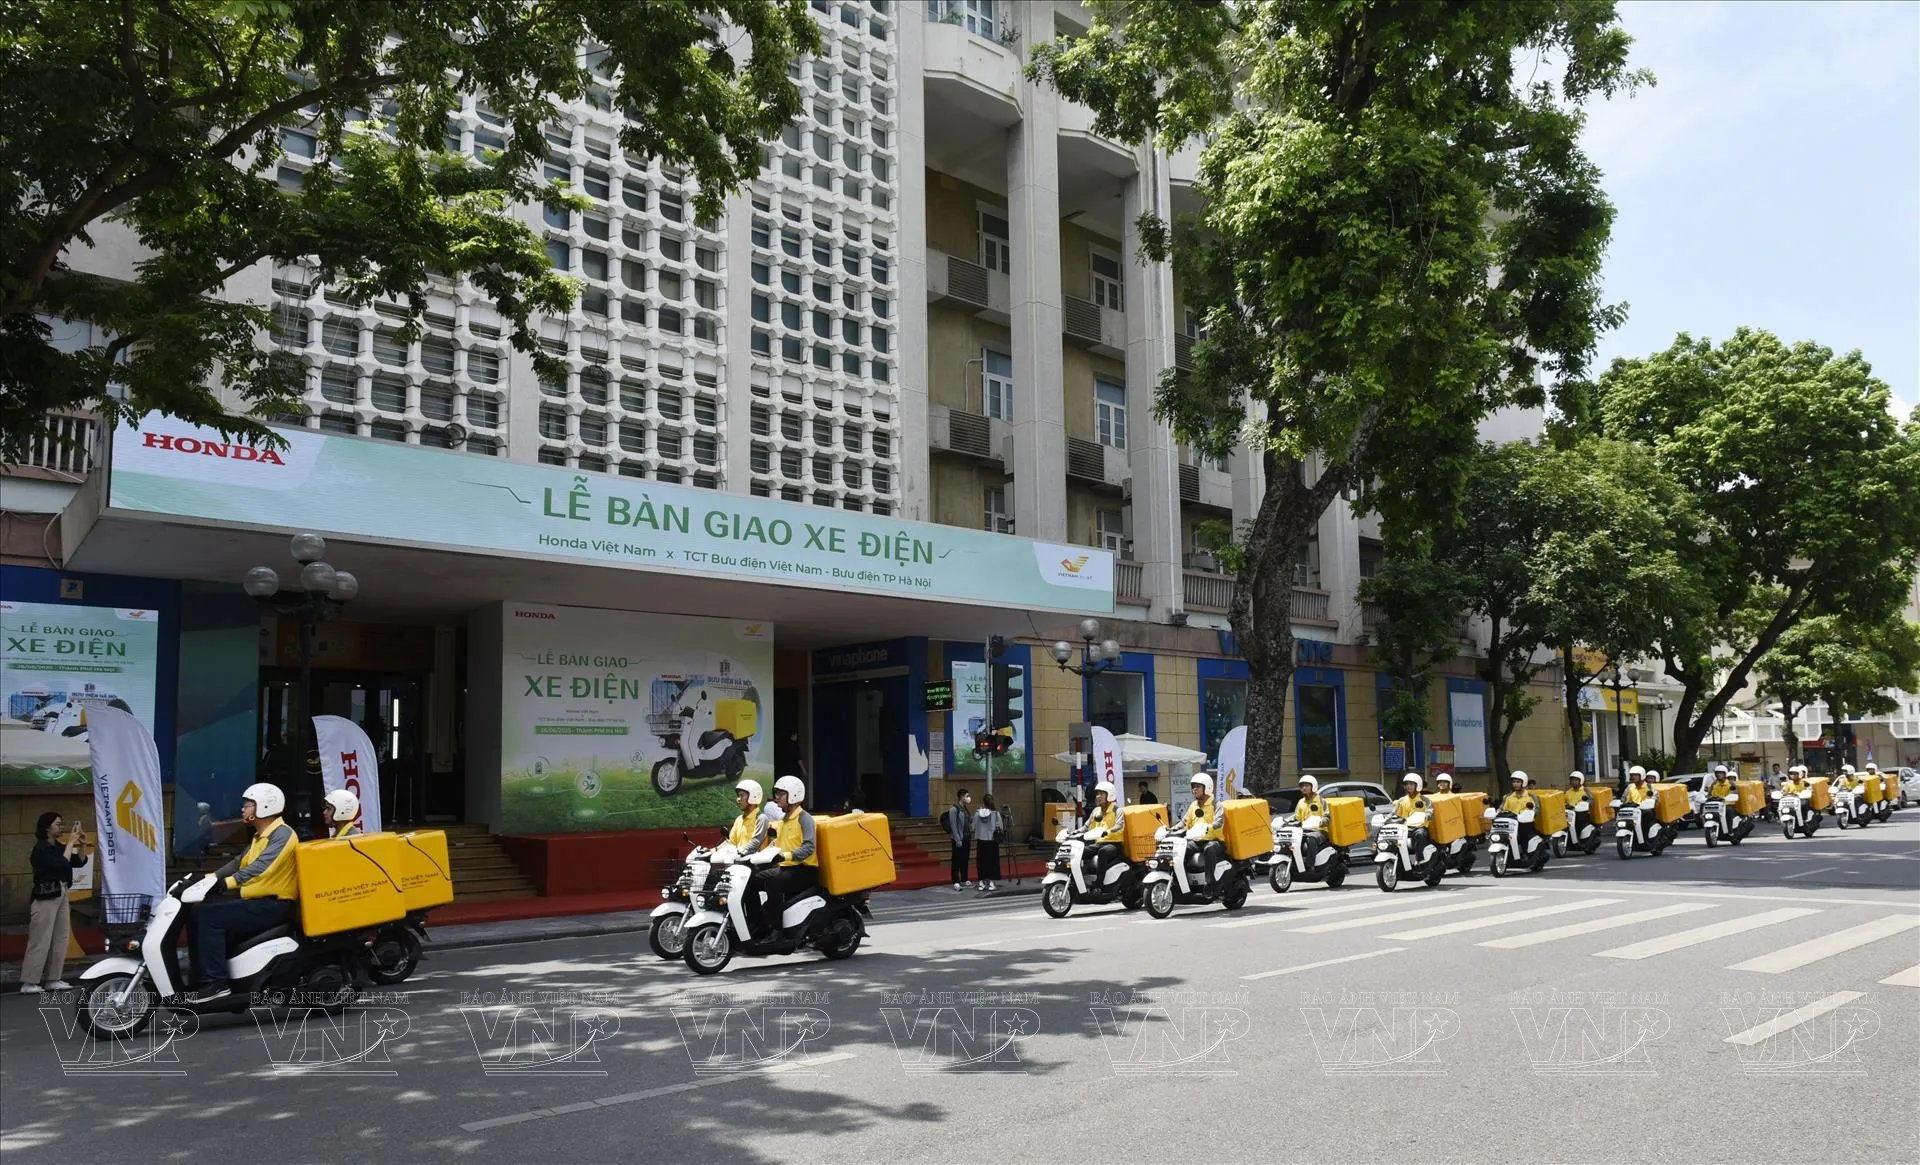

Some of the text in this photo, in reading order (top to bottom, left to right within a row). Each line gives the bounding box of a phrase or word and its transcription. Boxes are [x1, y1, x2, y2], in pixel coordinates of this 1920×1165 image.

[142, 432, 286, 466] HONDA
[543, 475, 934, 567] LỄ BÀN GIAO XE ĐIỆN
[538, 533, 588, 550] Honda
[592, 540, 620, 555] Việt
[623, 543, 656, 558] Nam
[683, 550, 709, 563] TCT
[711, 553, 737, 566] Bưu
[739, 557, 767, 571] điện
[769, 559, 793, 574] Việt
[795, 564, 823, 576] Nam
[832, 567, 855, 580] Bưu
[857, 570, 881, 584] điện
[882, 573, 896, 584] TP
[899, 575, 913, 586] Hà
[915, 577, 932, 589] Nội
[21, 622, 115, 638] LỄ BÀN GIAO
[514, 610, 556, 620] HONDA
[6, 637, 126, 659] XE ĐIỆN
[537, 648, 628, 668] LỄ BÀN GIAO
[524, 672, 639, 705] XE ĐIỆN
[100, 774, 116, 864] VIETNAM POST
